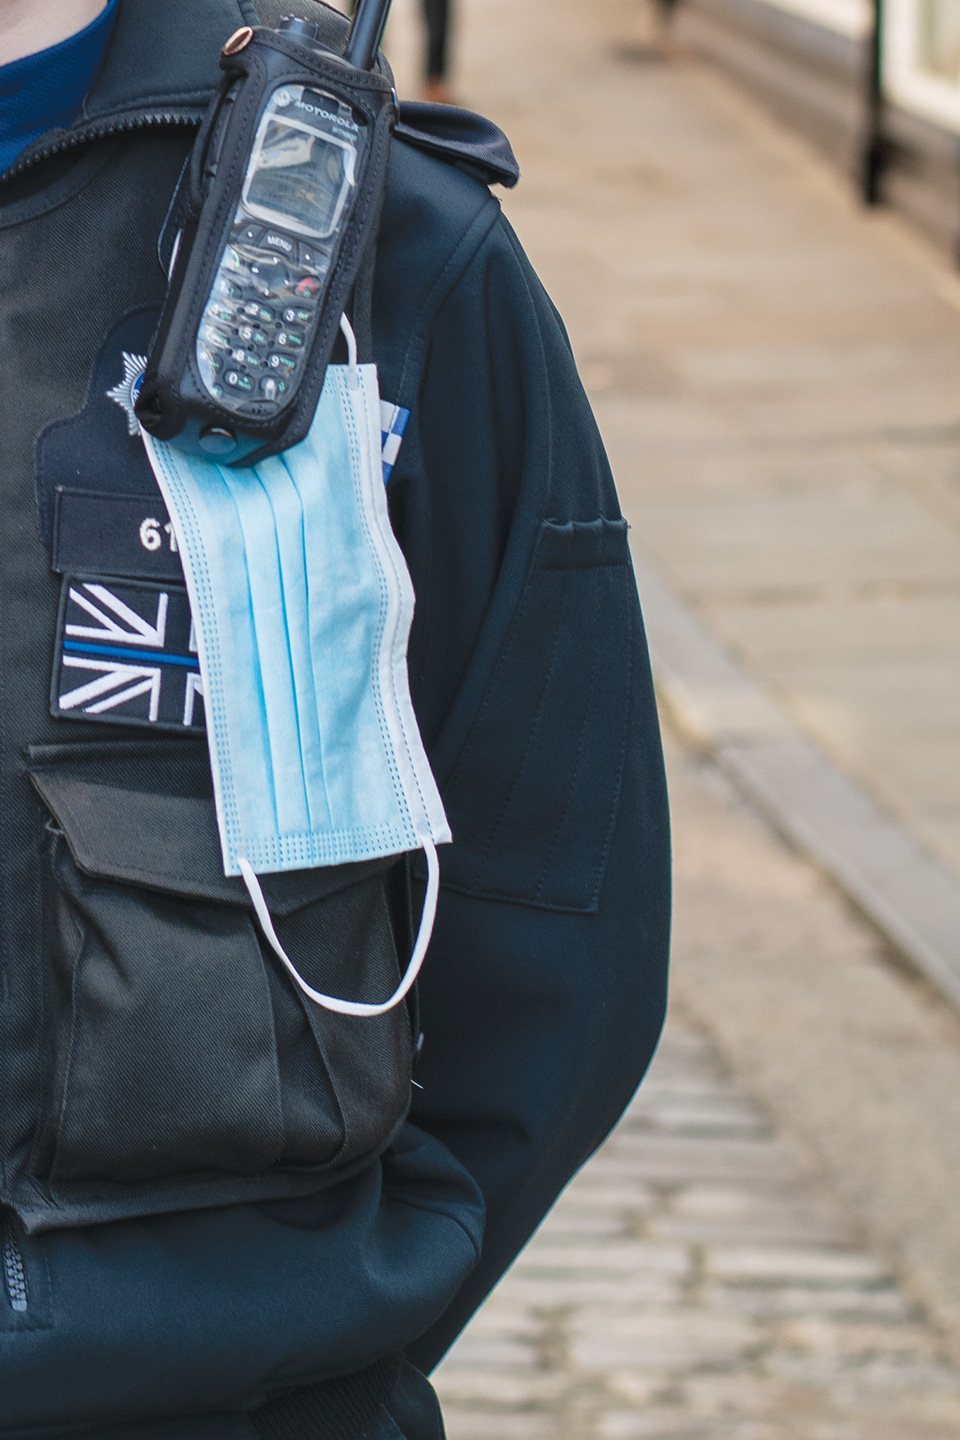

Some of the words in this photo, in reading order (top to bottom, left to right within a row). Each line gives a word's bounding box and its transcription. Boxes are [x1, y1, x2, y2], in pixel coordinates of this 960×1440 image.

[294, 100, 359, 133] MOTOROLA
[267, 235, 292, 252] MENU
[247, 303, 259, 316] 2
[286, 309, 295, 322] 3
[243, 326, 252, 340] 5
[278, 333, 287, 345] 6
[235, 349, 245, 361] 8
[271, 355, 280, 367] 9
[229, 372, 238, 385] 0
[139, 517, 178, 552] 61
